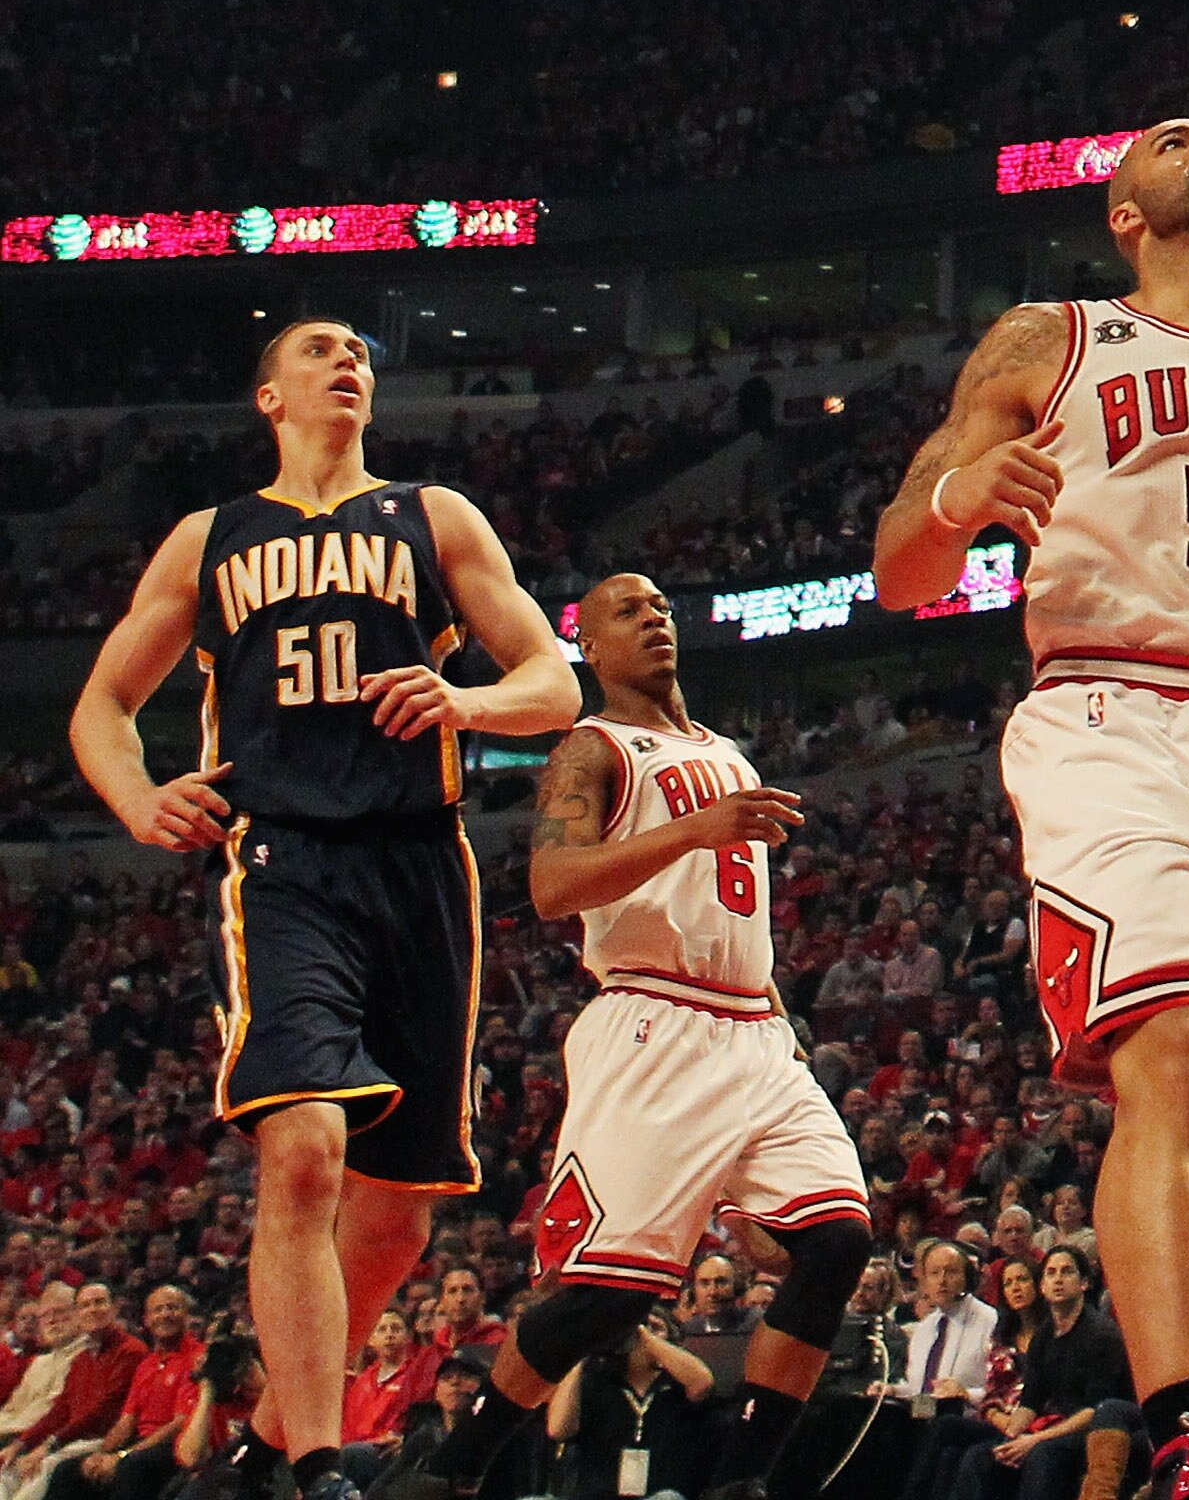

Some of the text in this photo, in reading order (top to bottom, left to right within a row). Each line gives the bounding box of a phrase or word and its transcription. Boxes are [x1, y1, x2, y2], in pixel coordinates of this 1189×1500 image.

[215, 531, 417, 636] INDIANA
[276, 620, 360, 706] 50
[715, 840, 758, 921] 6
